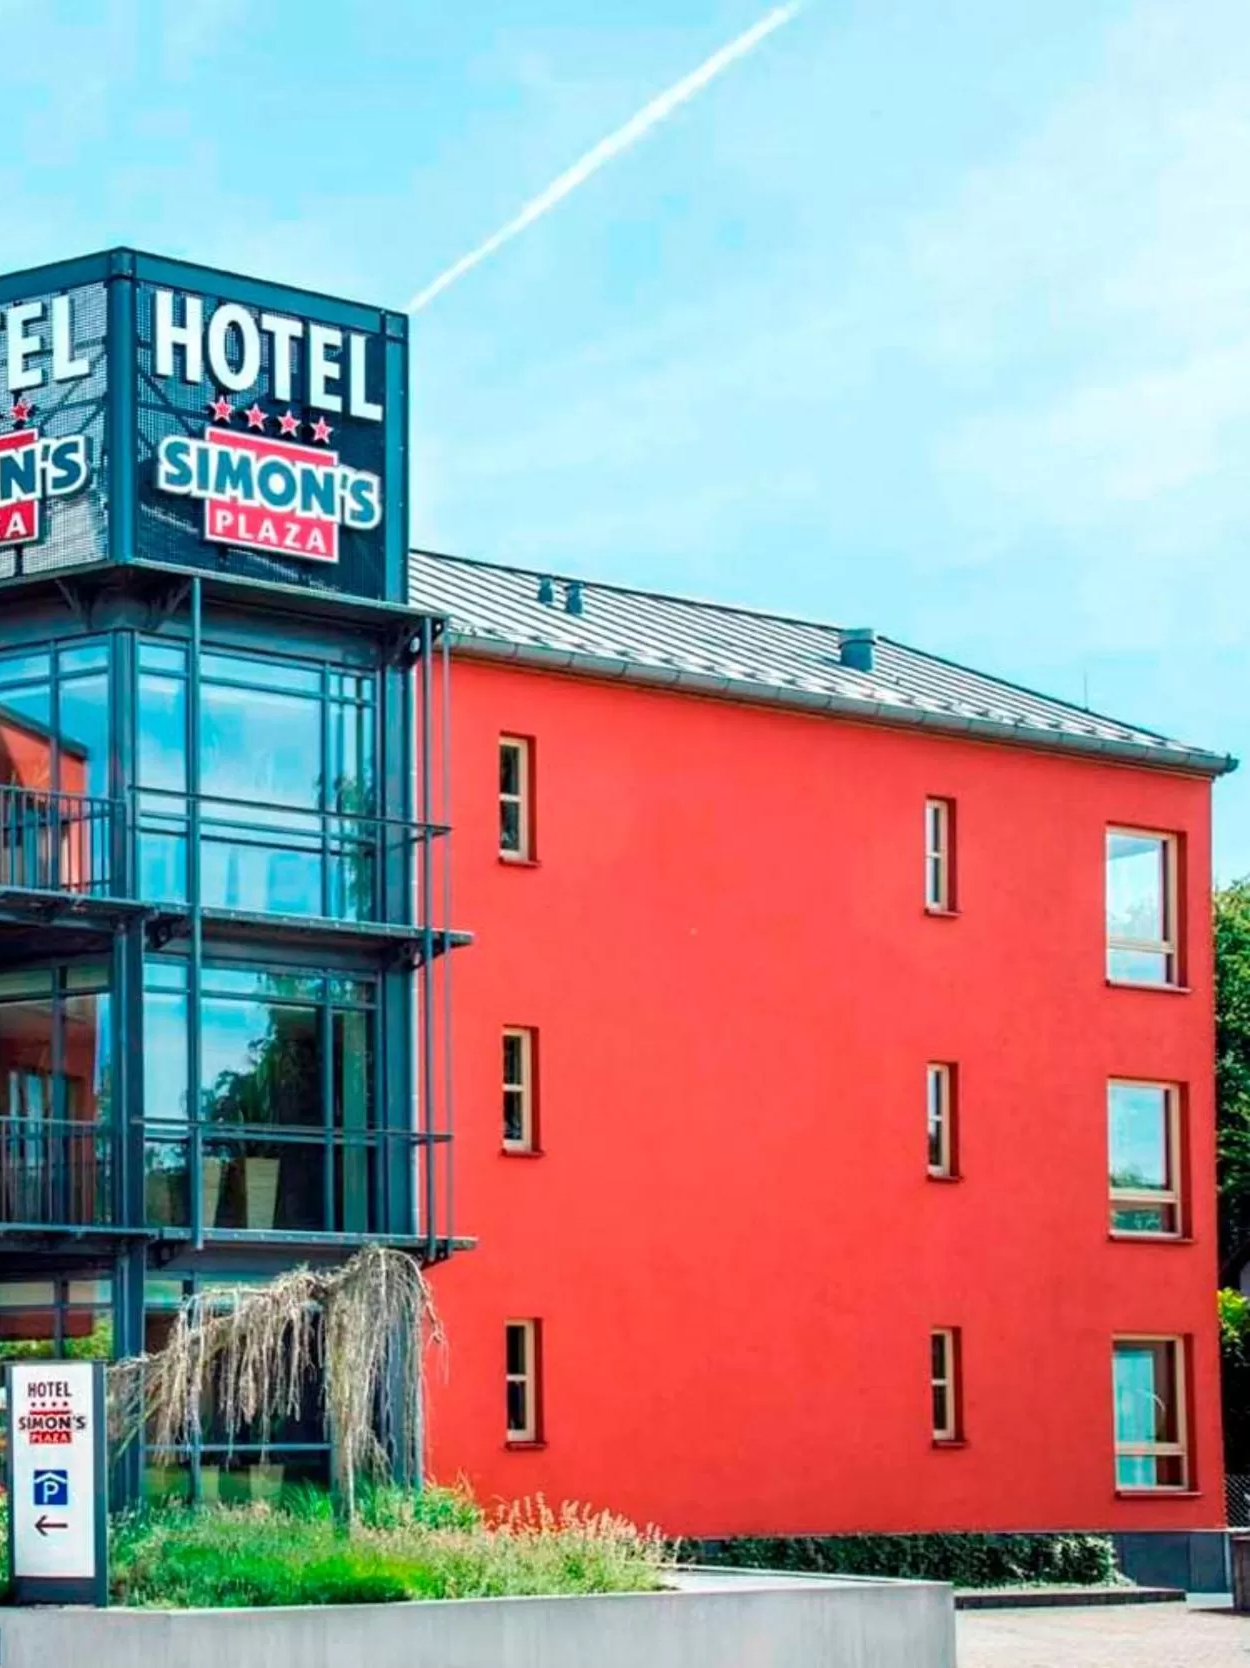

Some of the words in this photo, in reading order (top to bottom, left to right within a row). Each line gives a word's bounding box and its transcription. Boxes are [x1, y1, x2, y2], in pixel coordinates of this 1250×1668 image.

[155, 290, 383, 421] HOTEL
[160, 438, 379, 526] SIMON'S
[214, 508, 328, 553] PLAZA
[28, 1381, 72, 1397] HOTEL
[19, 1416, 86, 1430] SIMON'S
